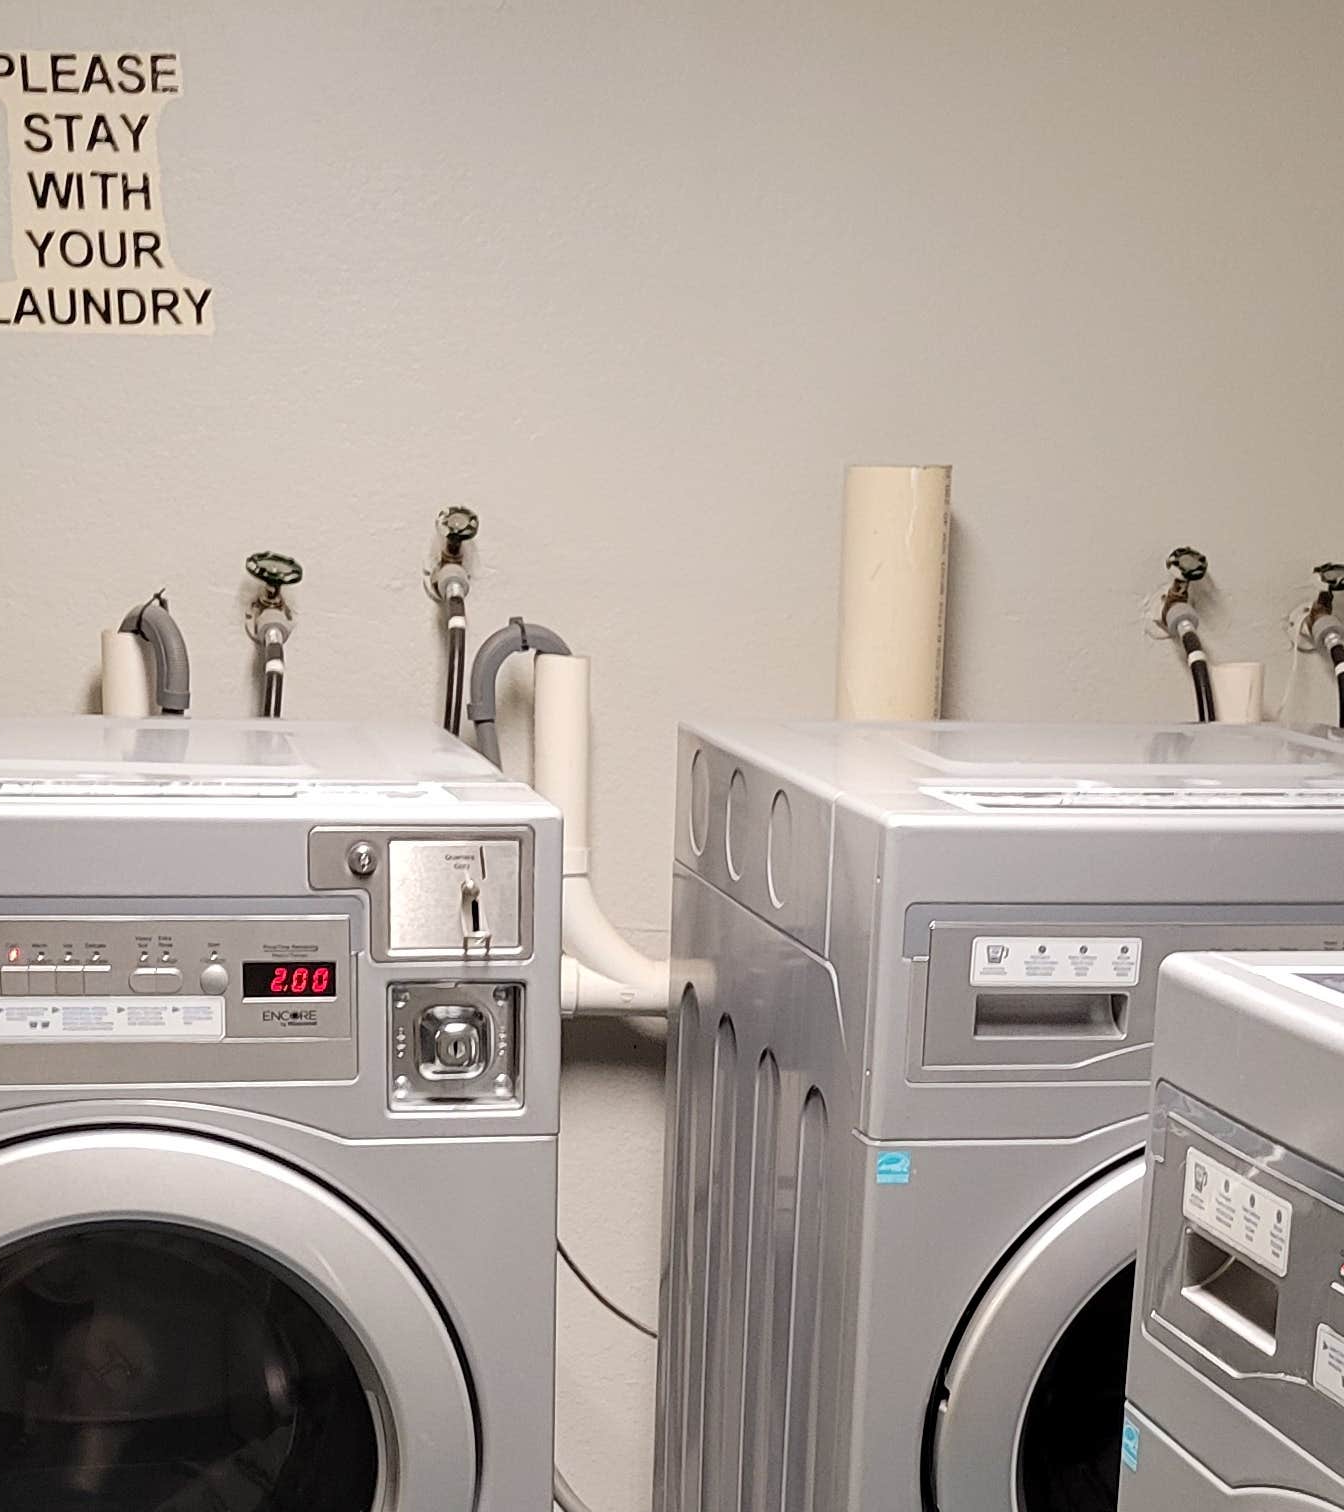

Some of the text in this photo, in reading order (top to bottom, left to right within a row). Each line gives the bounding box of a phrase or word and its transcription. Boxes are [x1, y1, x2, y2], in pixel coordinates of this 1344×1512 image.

[23, 112, 150, 152] STAY
[26, 171, 152, 211] WITH
[25, 229, 165, 269] YOUR
[270, 967, 329, 993] 2.00
[262, 1009, 318, 1022] ENCORE
